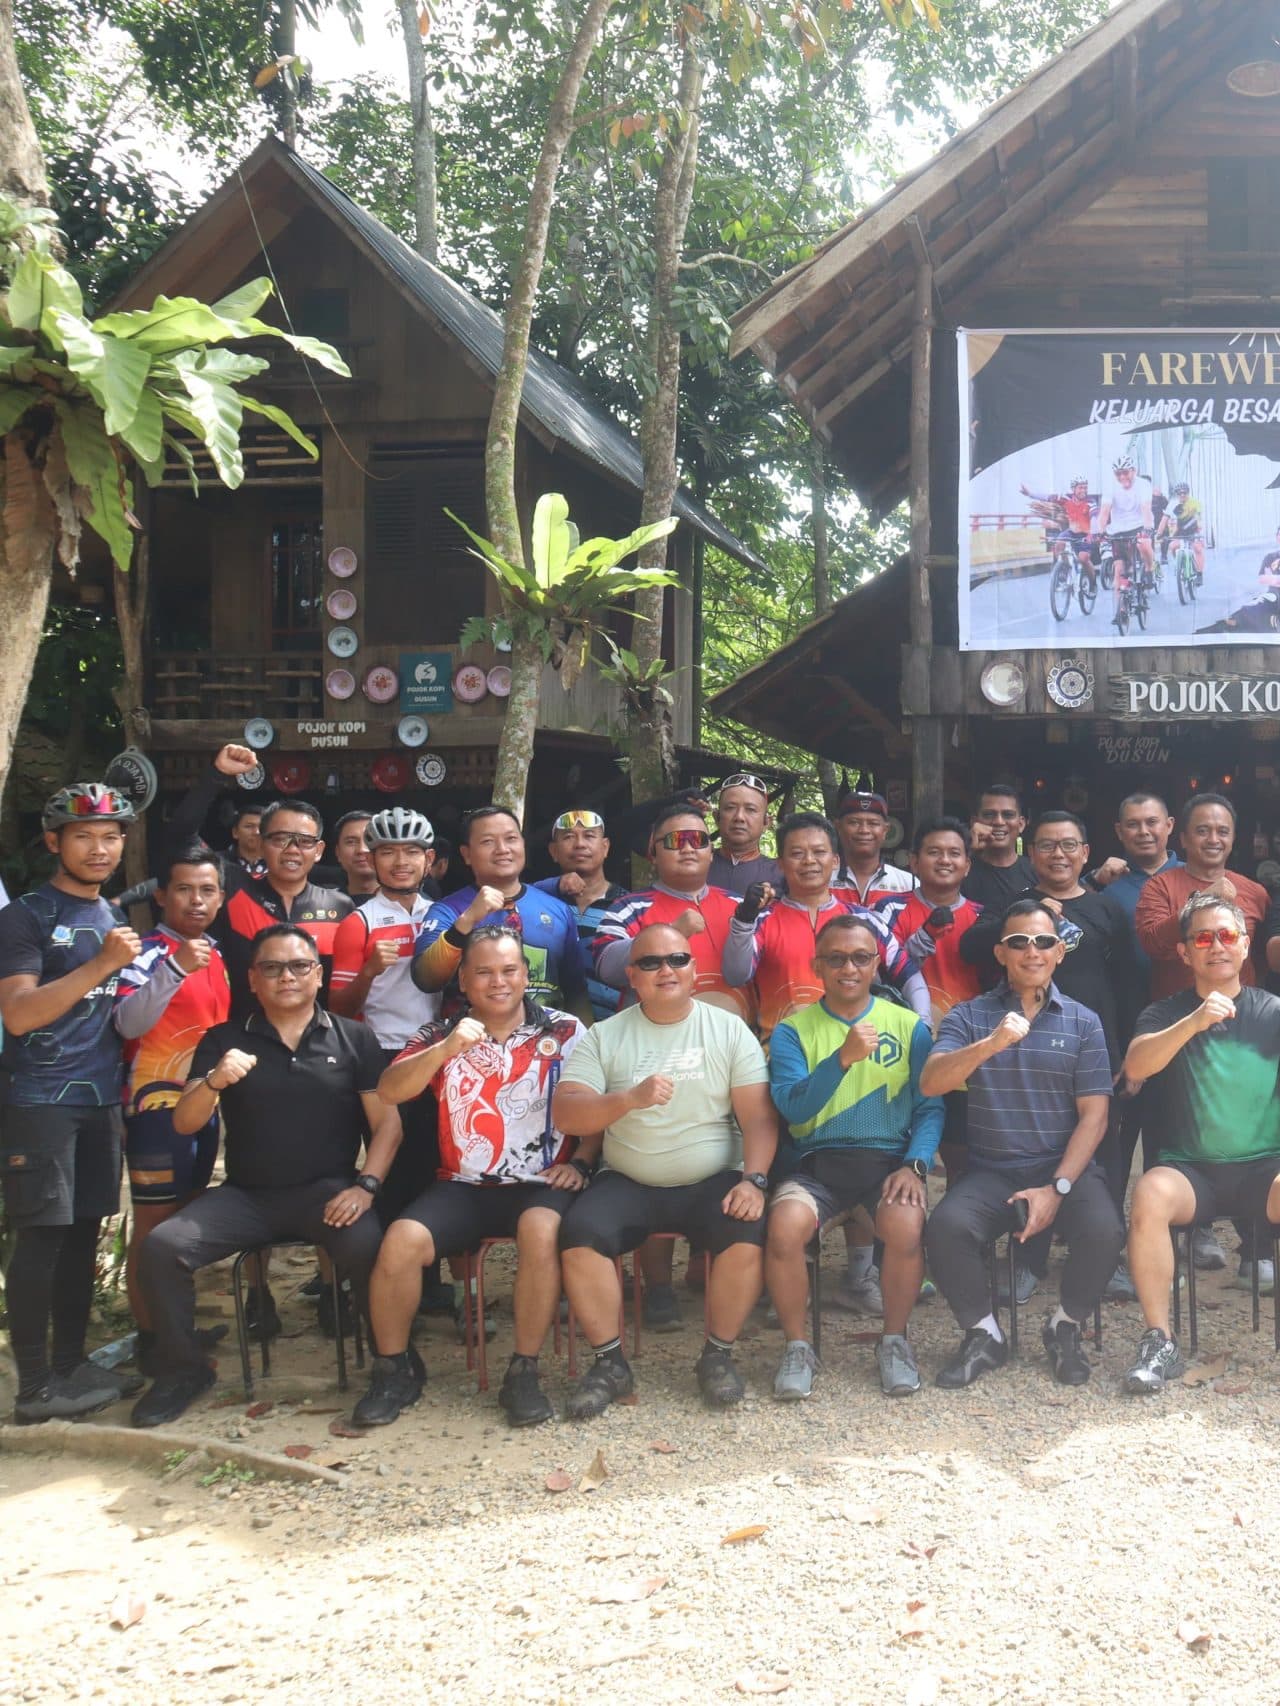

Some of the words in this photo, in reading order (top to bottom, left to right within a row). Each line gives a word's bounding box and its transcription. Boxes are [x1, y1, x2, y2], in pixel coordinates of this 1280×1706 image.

[1089, 398, 1215, 424] KELUARGA
[1128, 681, 1233, 713] POJOK
[297, 722, 335, 734] POJOK
[338, 721, 366, 733] KOPI
[311, 735, 349, 747] DUSUN
[1105, 747, 1171, 764] DUSUN
